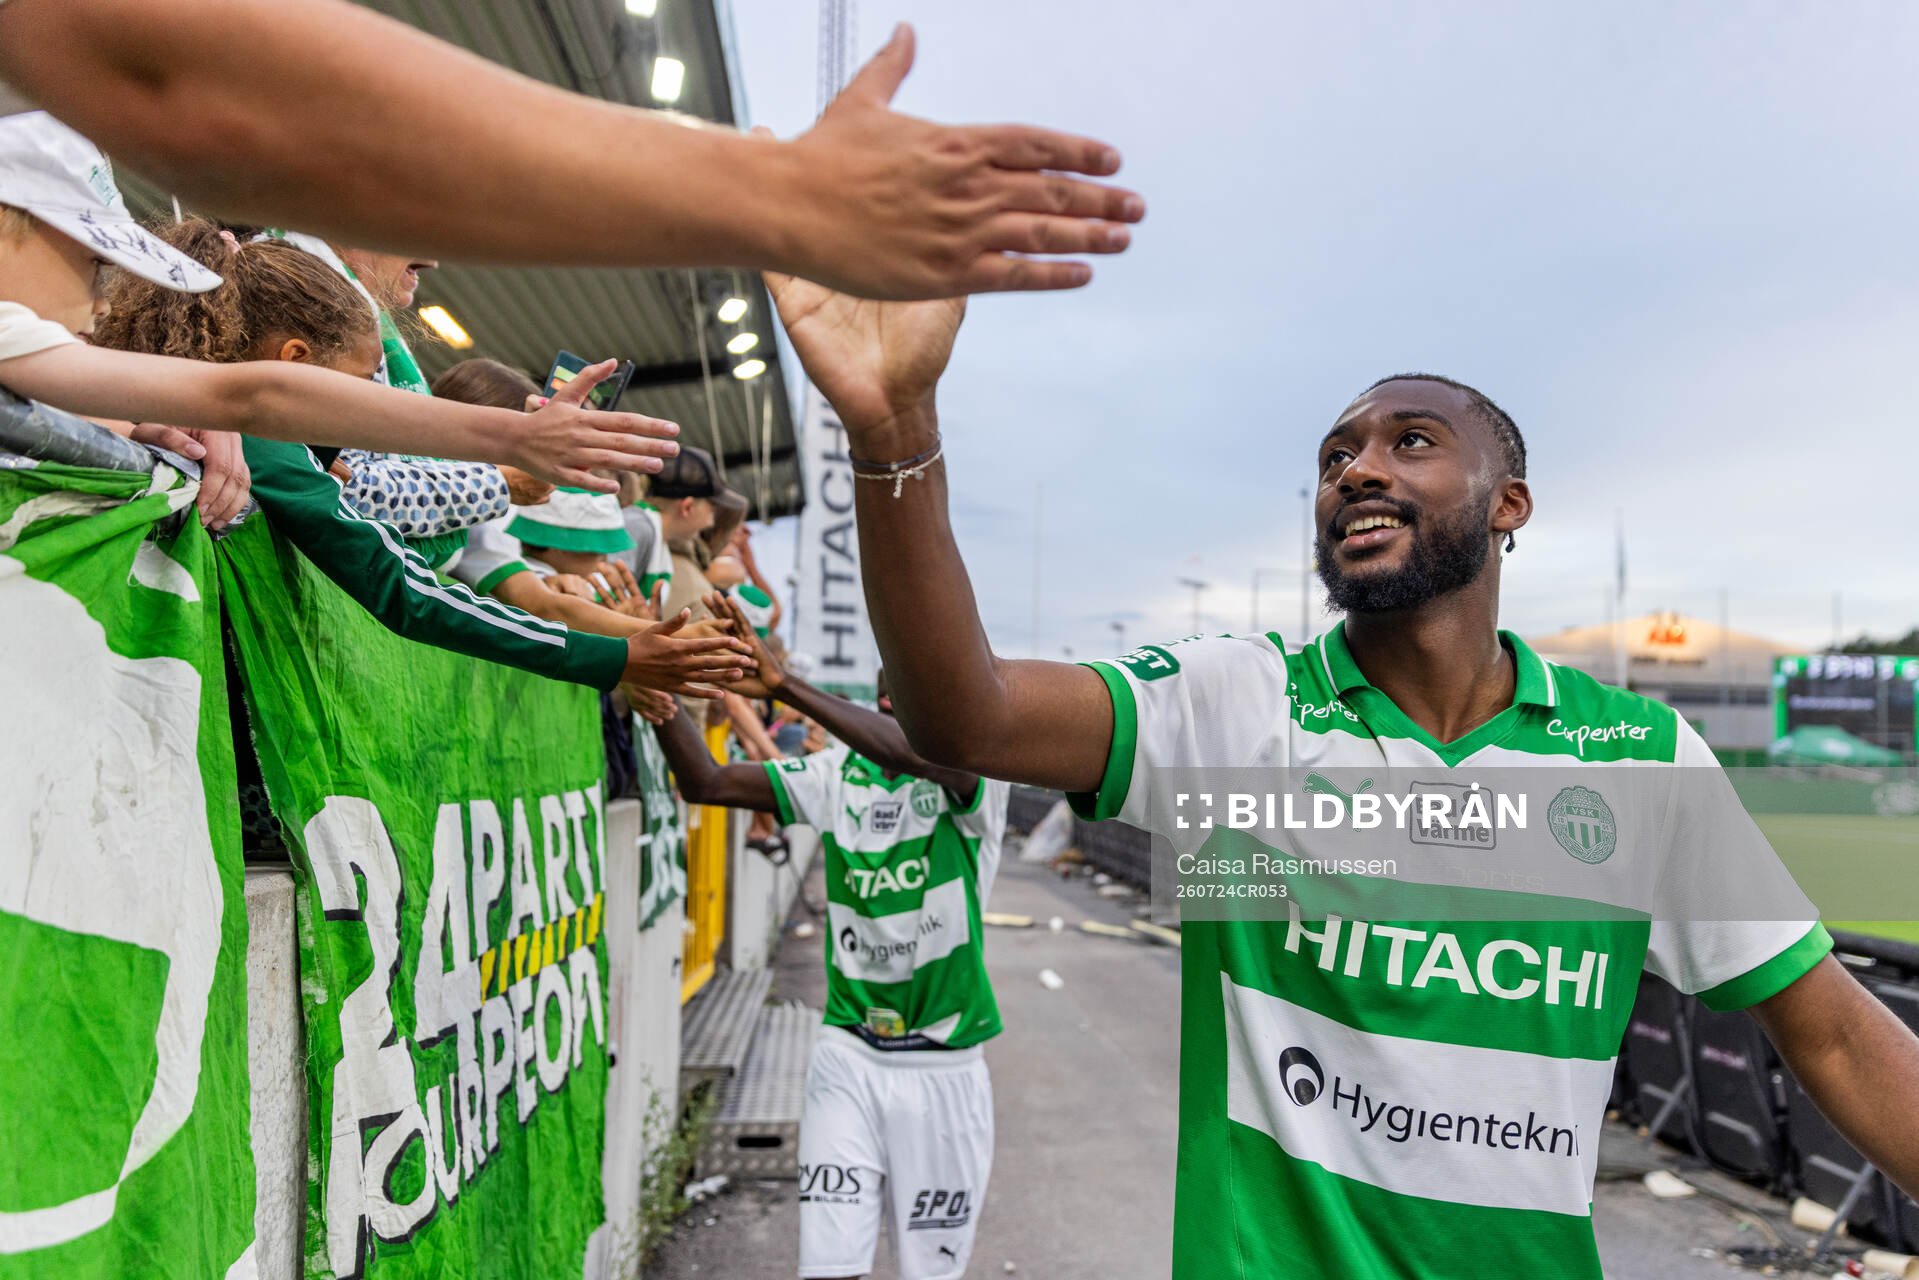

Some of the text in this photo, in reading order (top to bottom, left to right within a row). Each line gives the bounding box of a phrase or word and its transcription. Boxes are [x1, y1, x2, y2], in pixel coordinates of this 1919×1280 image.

[1547, 718, 1654, 757] Carpenter
[1572, 806, 1595, 818] VSK
[1284, 900, 1609, 1010] HITACHI
